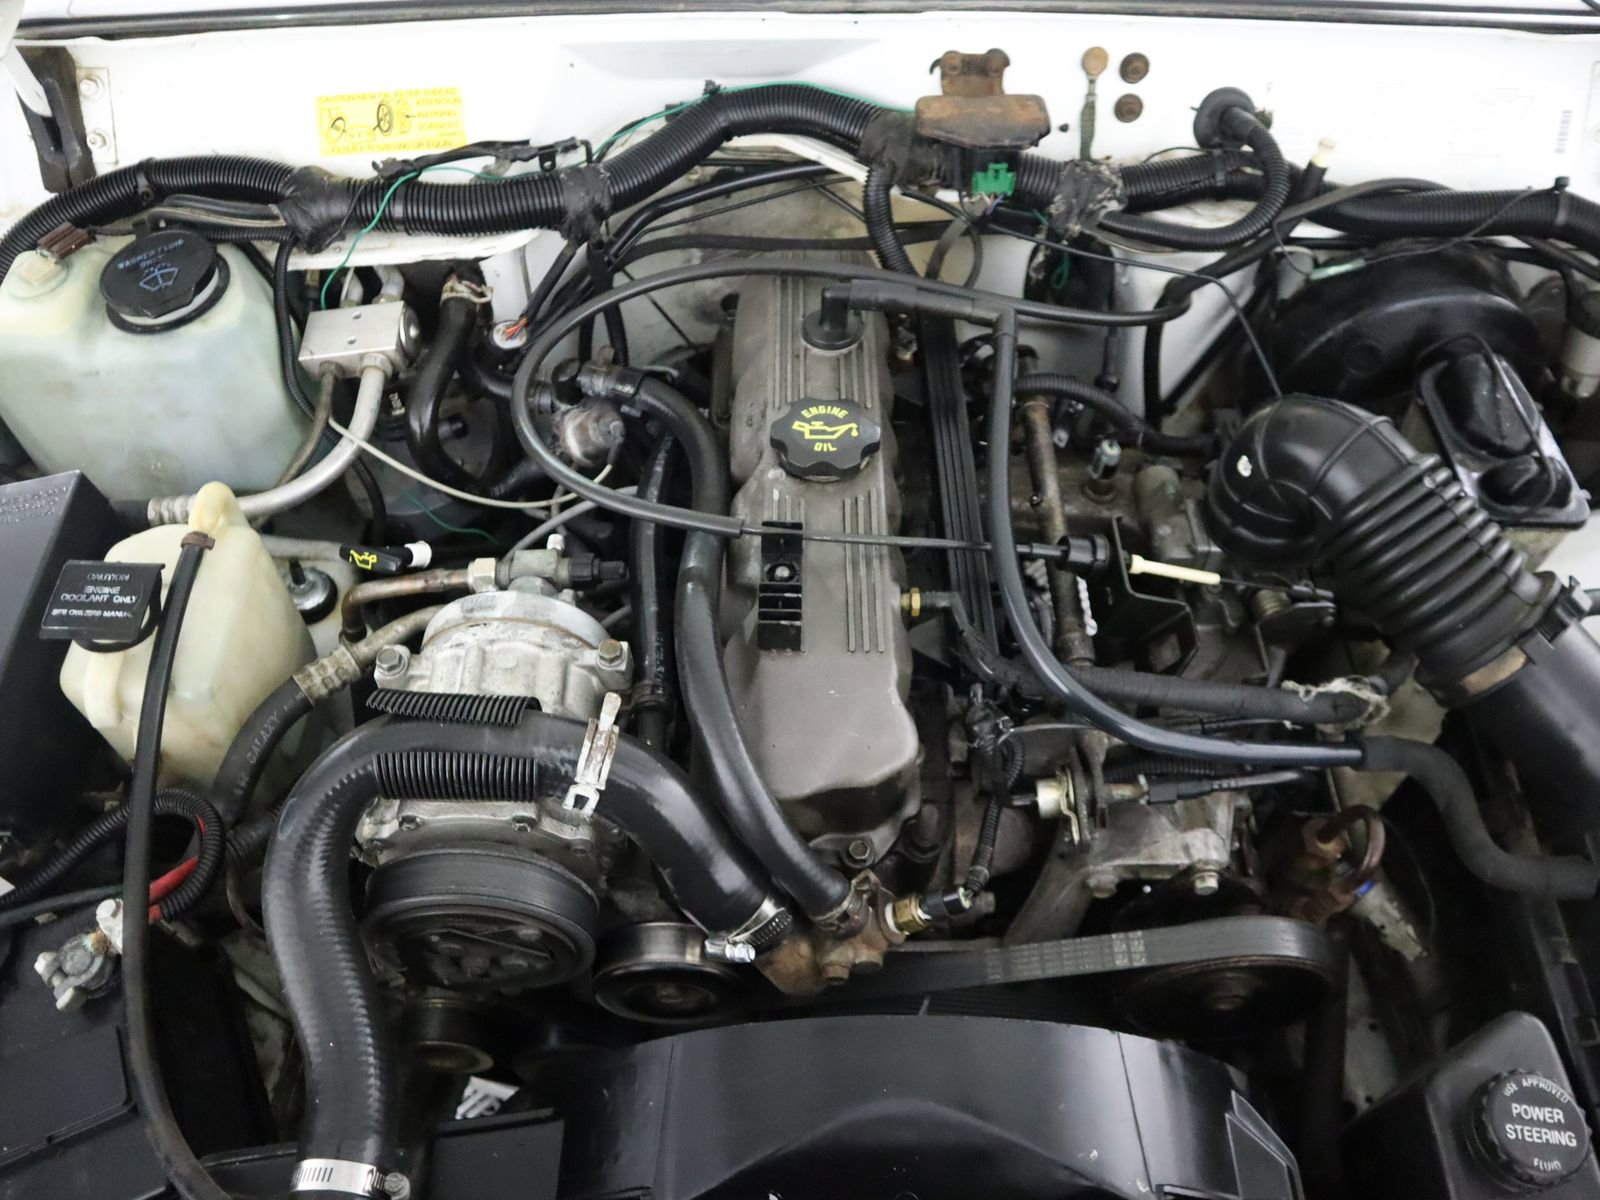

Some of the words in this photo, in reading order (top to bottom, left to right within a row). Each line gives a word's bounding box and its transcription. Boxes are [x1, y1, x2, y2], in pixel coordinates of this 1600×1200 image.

[117, 249, 156, 269] WASHER
[801, 405, 849, 419] ENGINE
[813, 441, 838, 452] OIL
[60, 593, 109, 603] COOLANT
[112, 595, 138, 604] ONLY
[83, 585, 121, 595] ENGINE
[246, 710, 281, 765] GALAXY
[1503, 1081, 1519, 1097] USE
[1521, 1077, 1569, 1104] APPROVED
[1511, 1103, 1565, 1124] POWER
[1505, 1123, 1577, 1147] STEERING
[1533, 1157, 1562, 1171] FLUID
